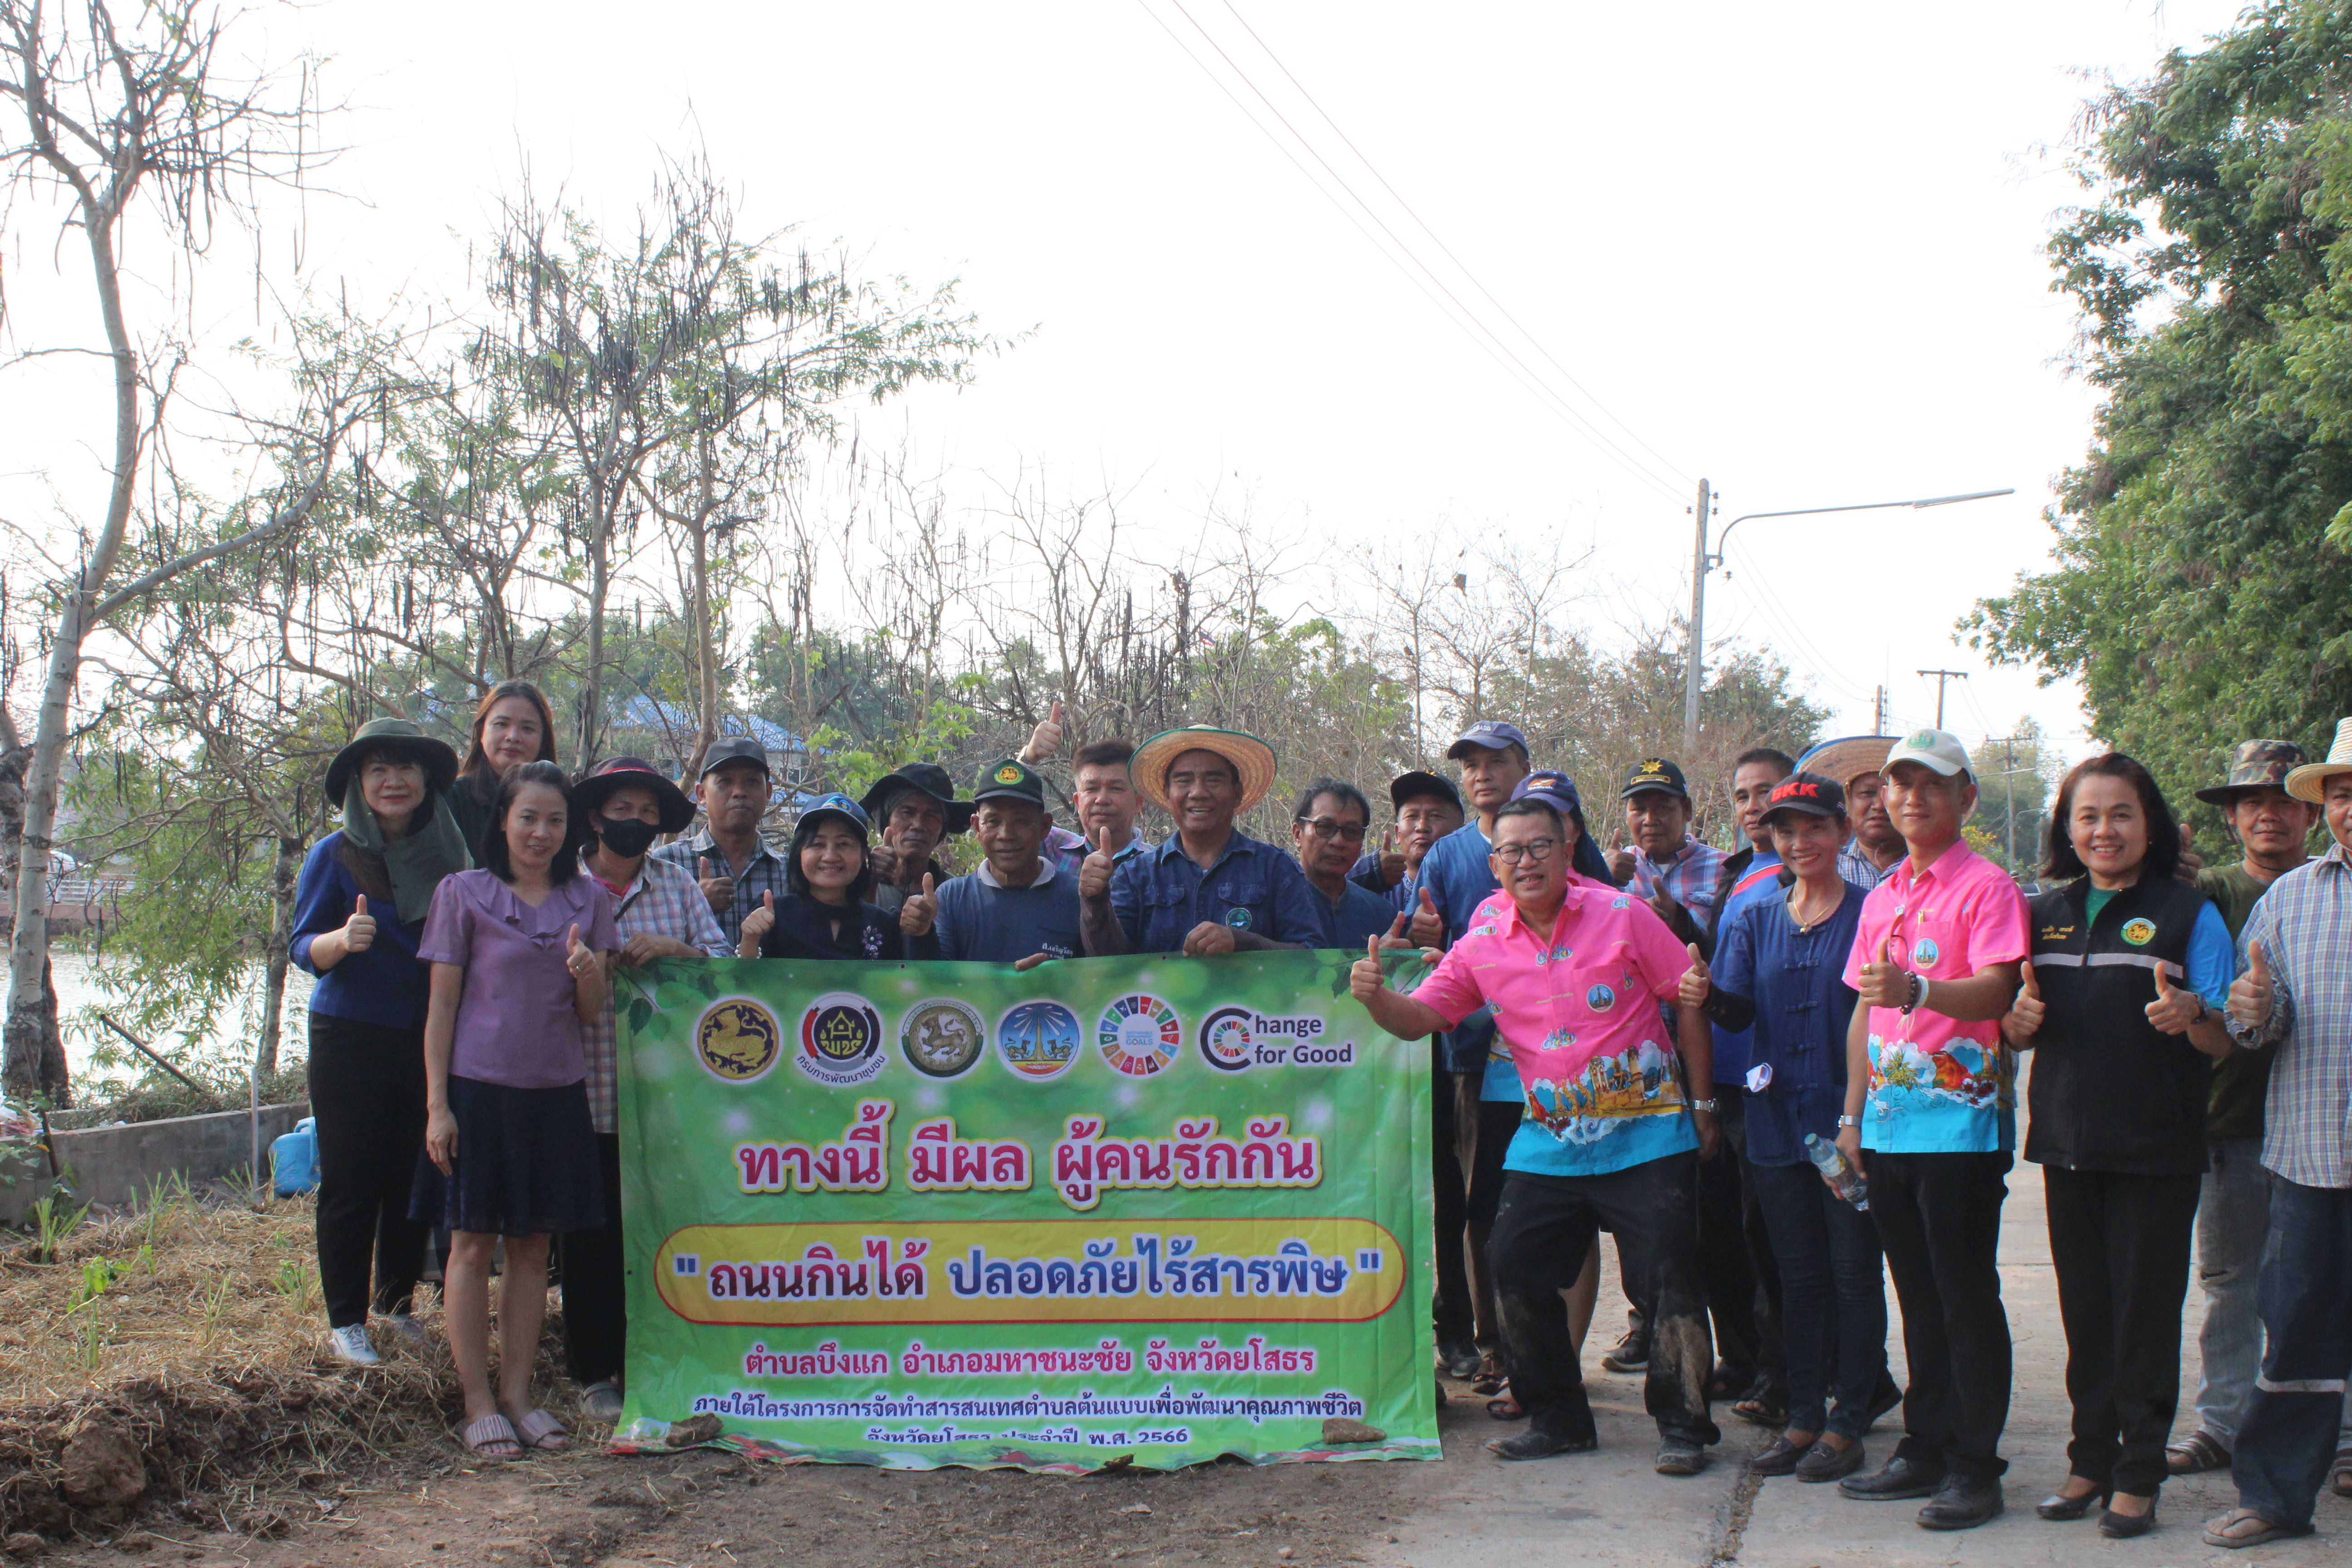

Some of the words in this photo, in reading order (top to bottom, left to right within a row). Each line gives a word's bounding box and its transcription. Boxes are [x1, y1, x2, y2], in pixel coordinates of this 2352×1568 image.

[1771, 782, 1819, 803] BKK
[1255, 1045, 1287, 1063] for
[1293, 1044, 1351, 1063] Good
[797, 1055, 886, 1083] กรมการพัฒนาชุมชน
[740, 1104, 887, 1184] ทางนี้
[912, 1123, 1024, 1183] มีผล
[1058, 1121, 1314, 1199] ผู้คนรักกัน
[746, 1342, 888, 1375] ตำบลบึงแก
[903, 1341, 1132, 1374] อำเภอมหาชนะชัย
[1146, 1338, 1314, 1372] จังหวัดยโสธร
[1089, 1432, 1132, 1445] พ.ศ.
[1138, 1428, 1188, 1443] 2566
